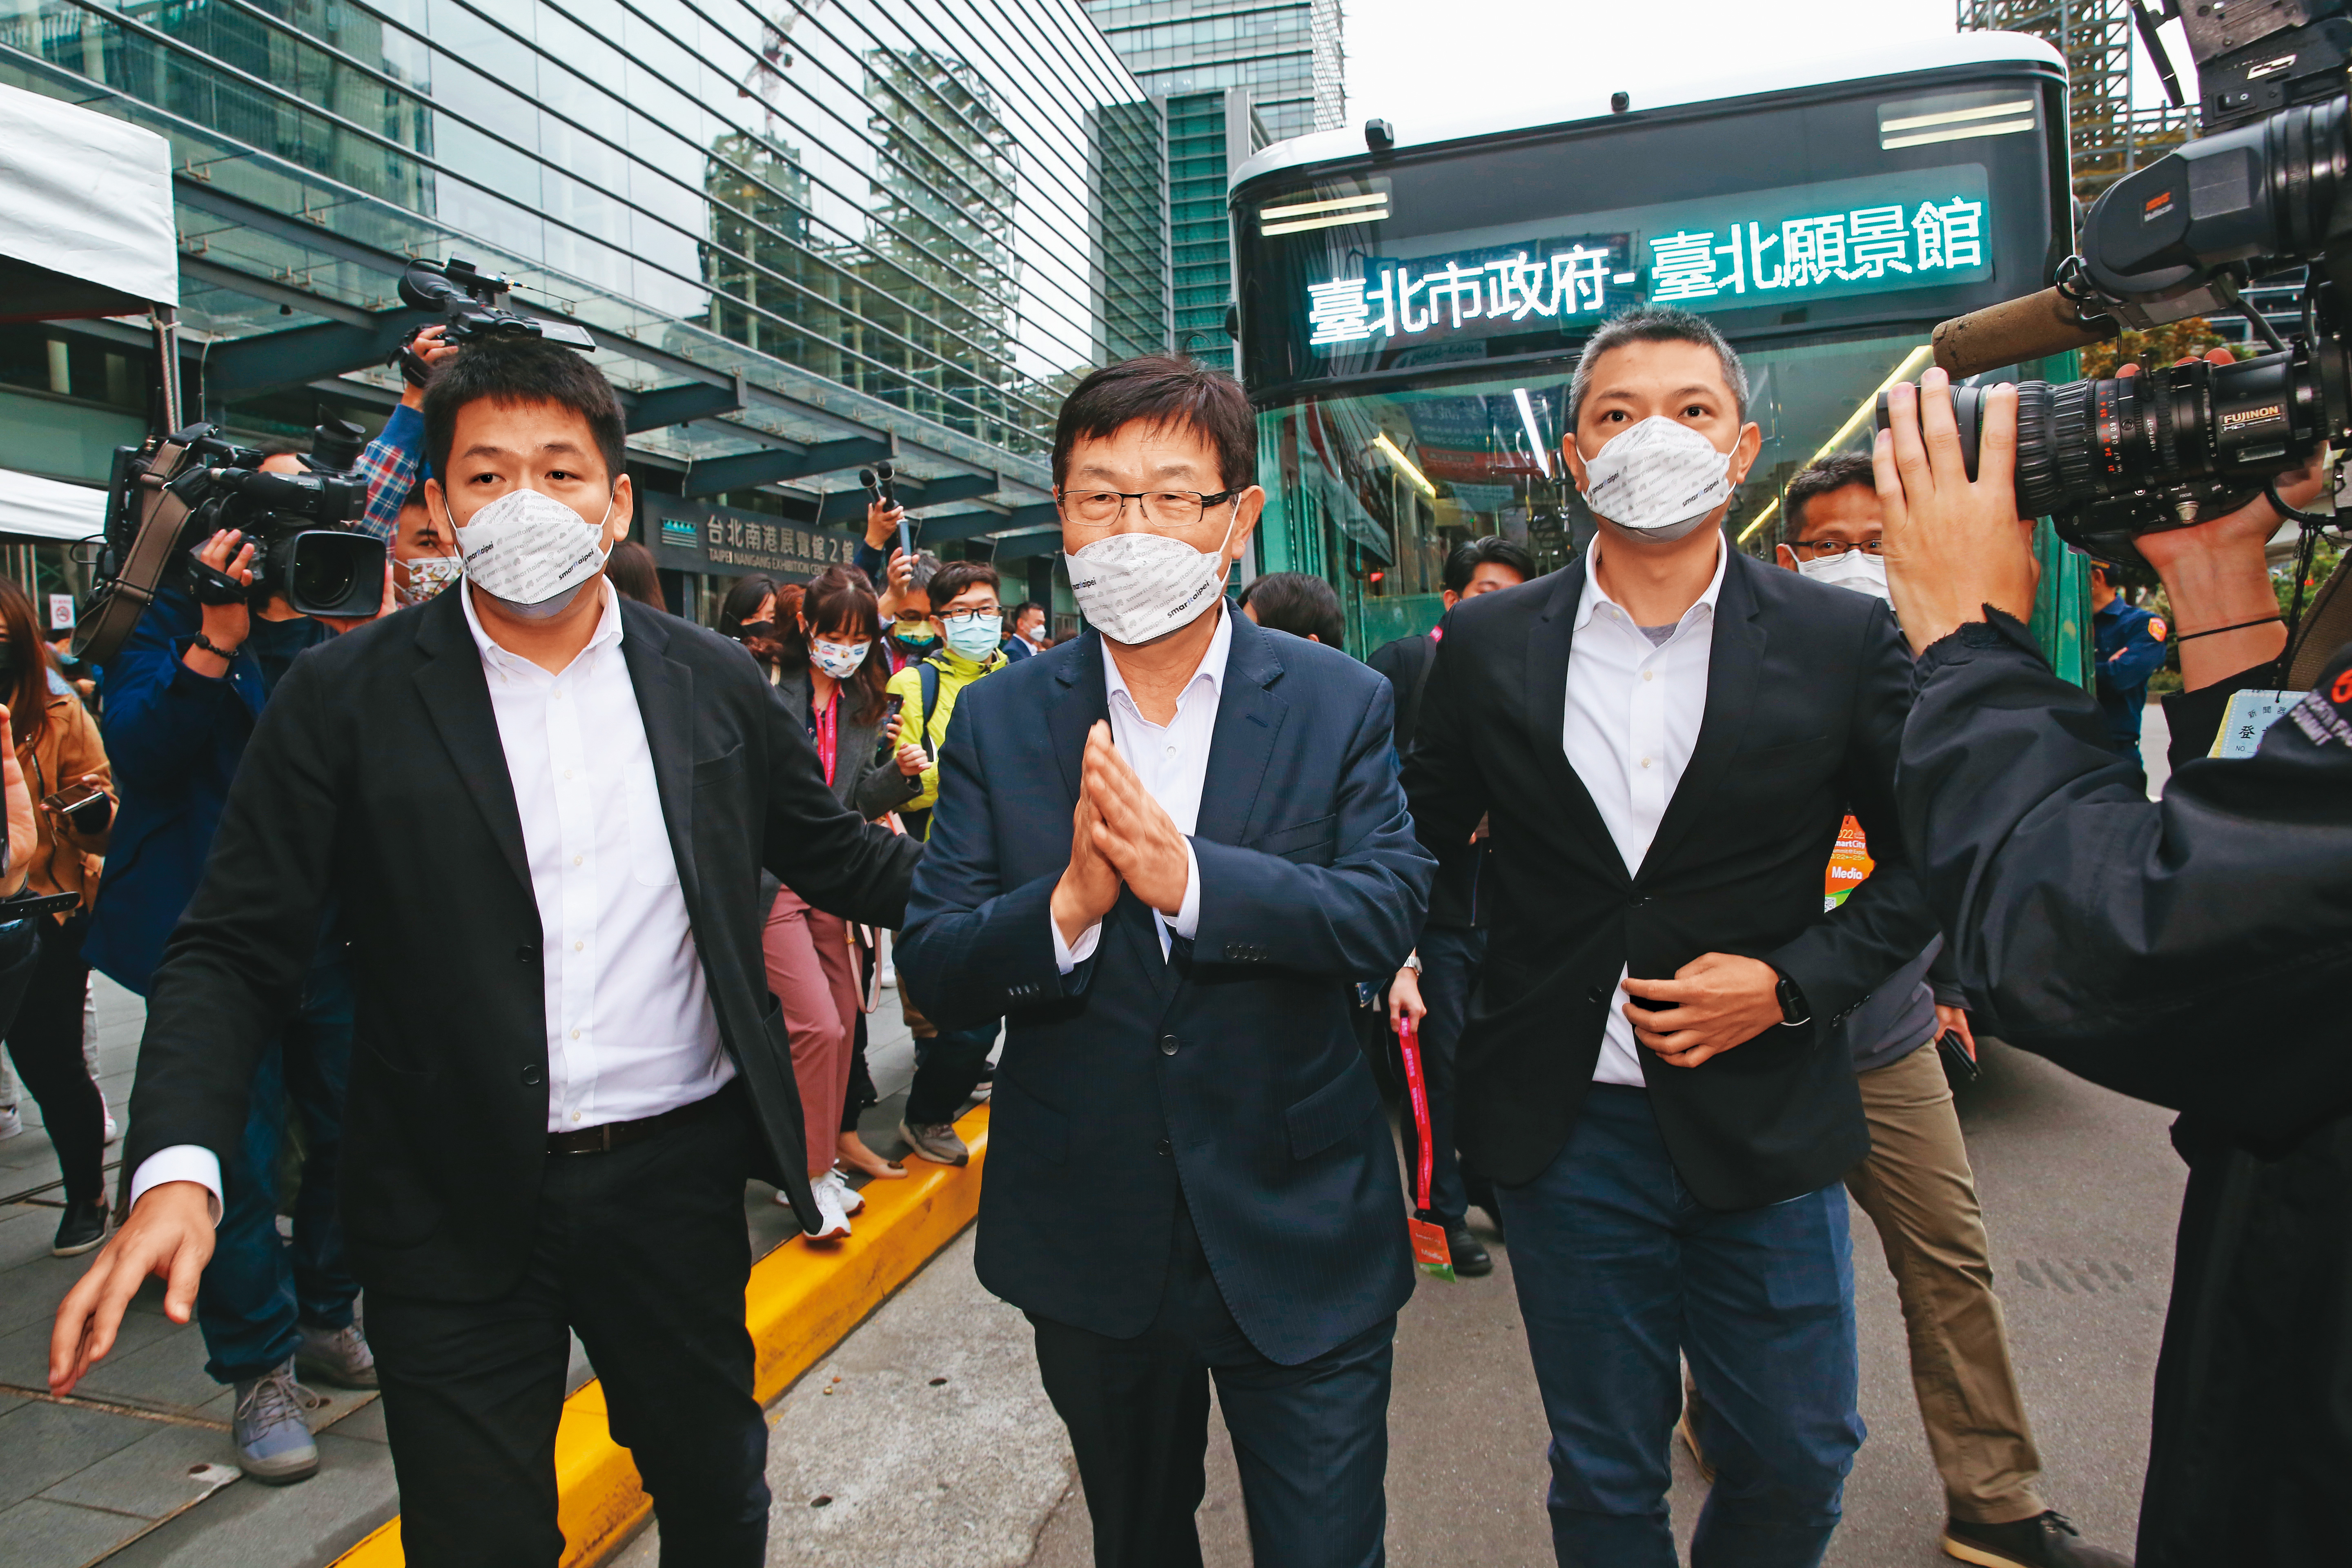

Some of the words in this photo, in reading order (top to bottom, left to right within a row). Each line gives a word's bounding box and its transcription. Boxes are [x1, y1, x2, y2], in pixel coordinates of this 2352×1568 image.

[1650, 196, 1982, 302] 臺北願景館
[2223, 405, 2279, 423] FUJINON
[708, 548, 733, 564] TAIPEI
[733, 552, 772, 569] NANGANG
[1831, 866, 1863, 880] Media
